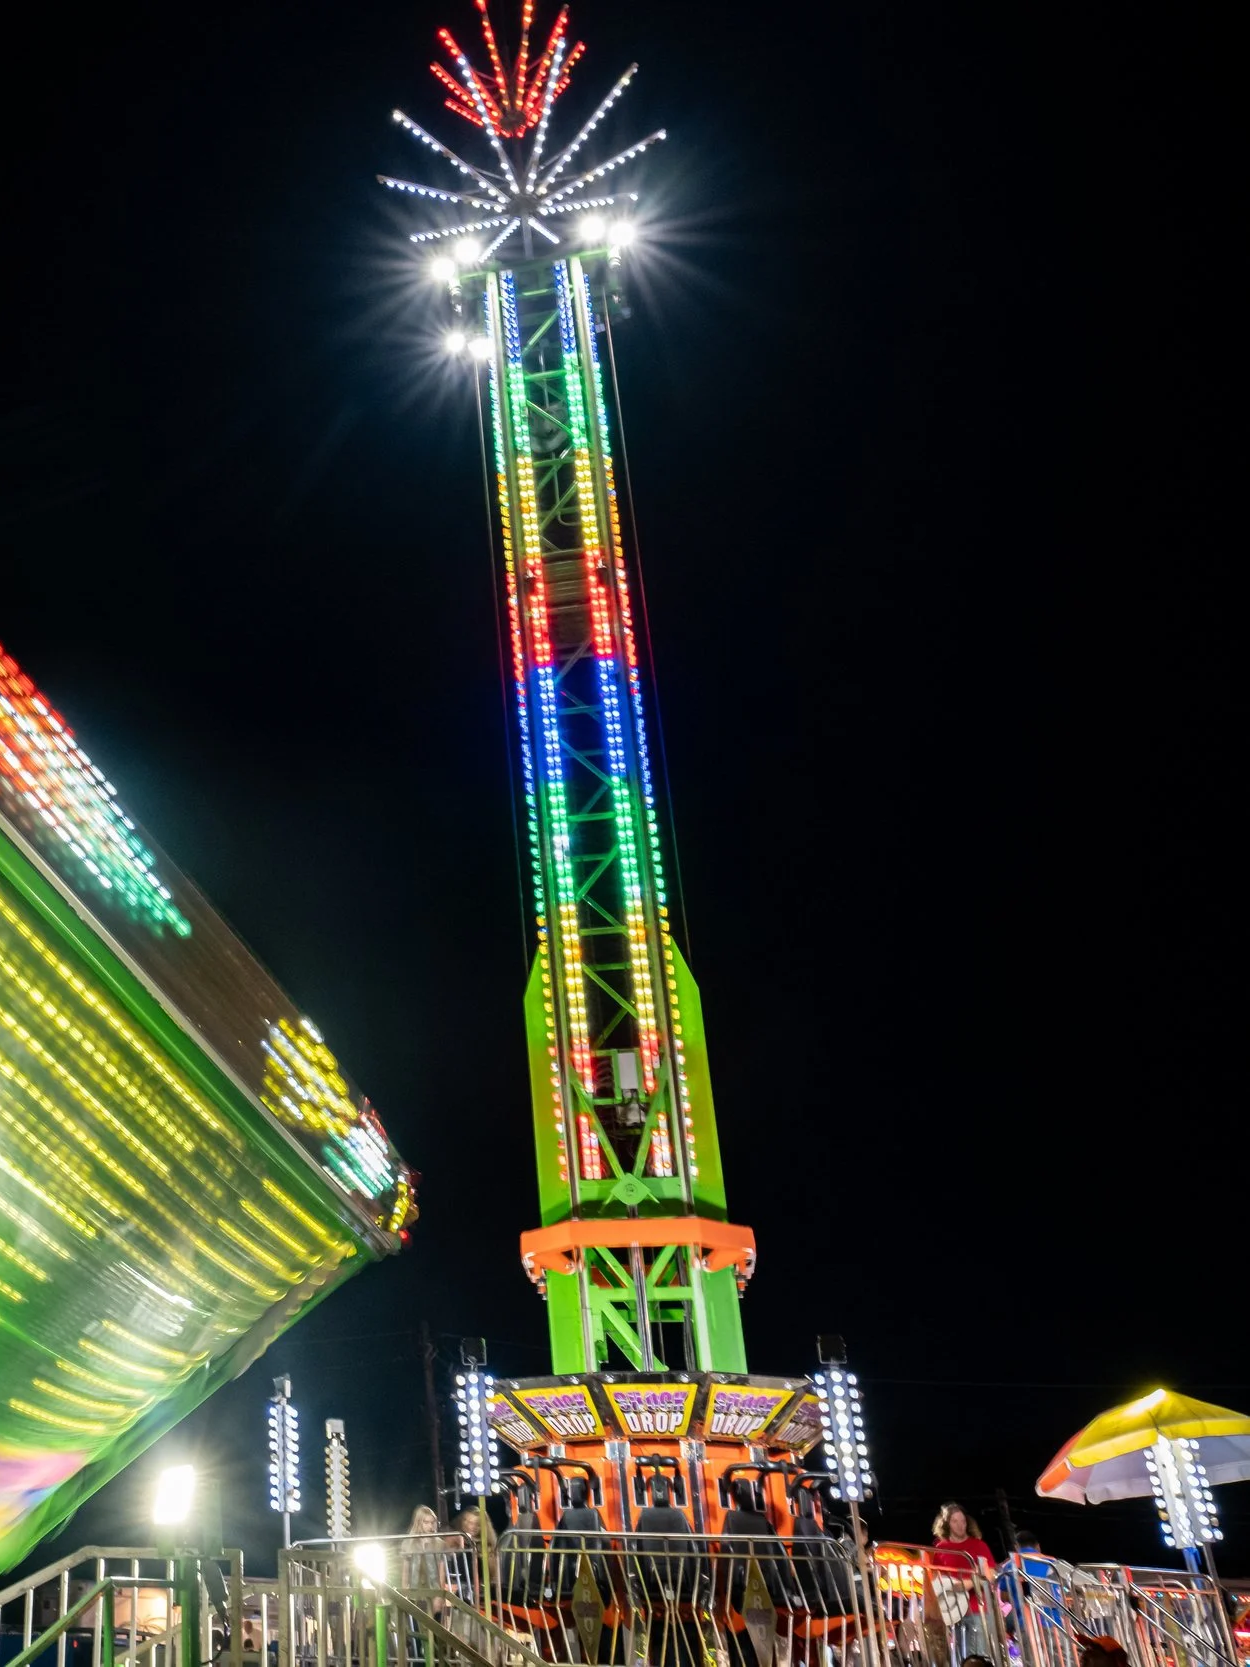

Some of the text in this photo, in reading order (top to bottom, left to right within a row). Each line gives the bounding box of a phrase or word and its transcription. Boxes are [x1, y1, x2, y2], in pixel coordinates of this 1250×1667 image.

[524, 1393, 589, 1416] SHOCK
[613, 1391, 688, 1413] SHOCK
[714, 1392, 782, 1415] SHOCK
[544, 1412, 596, 1436] DROP
[624, 1412, 683, 1433] DROP
[710, 1413, 766, 1436] DROP
